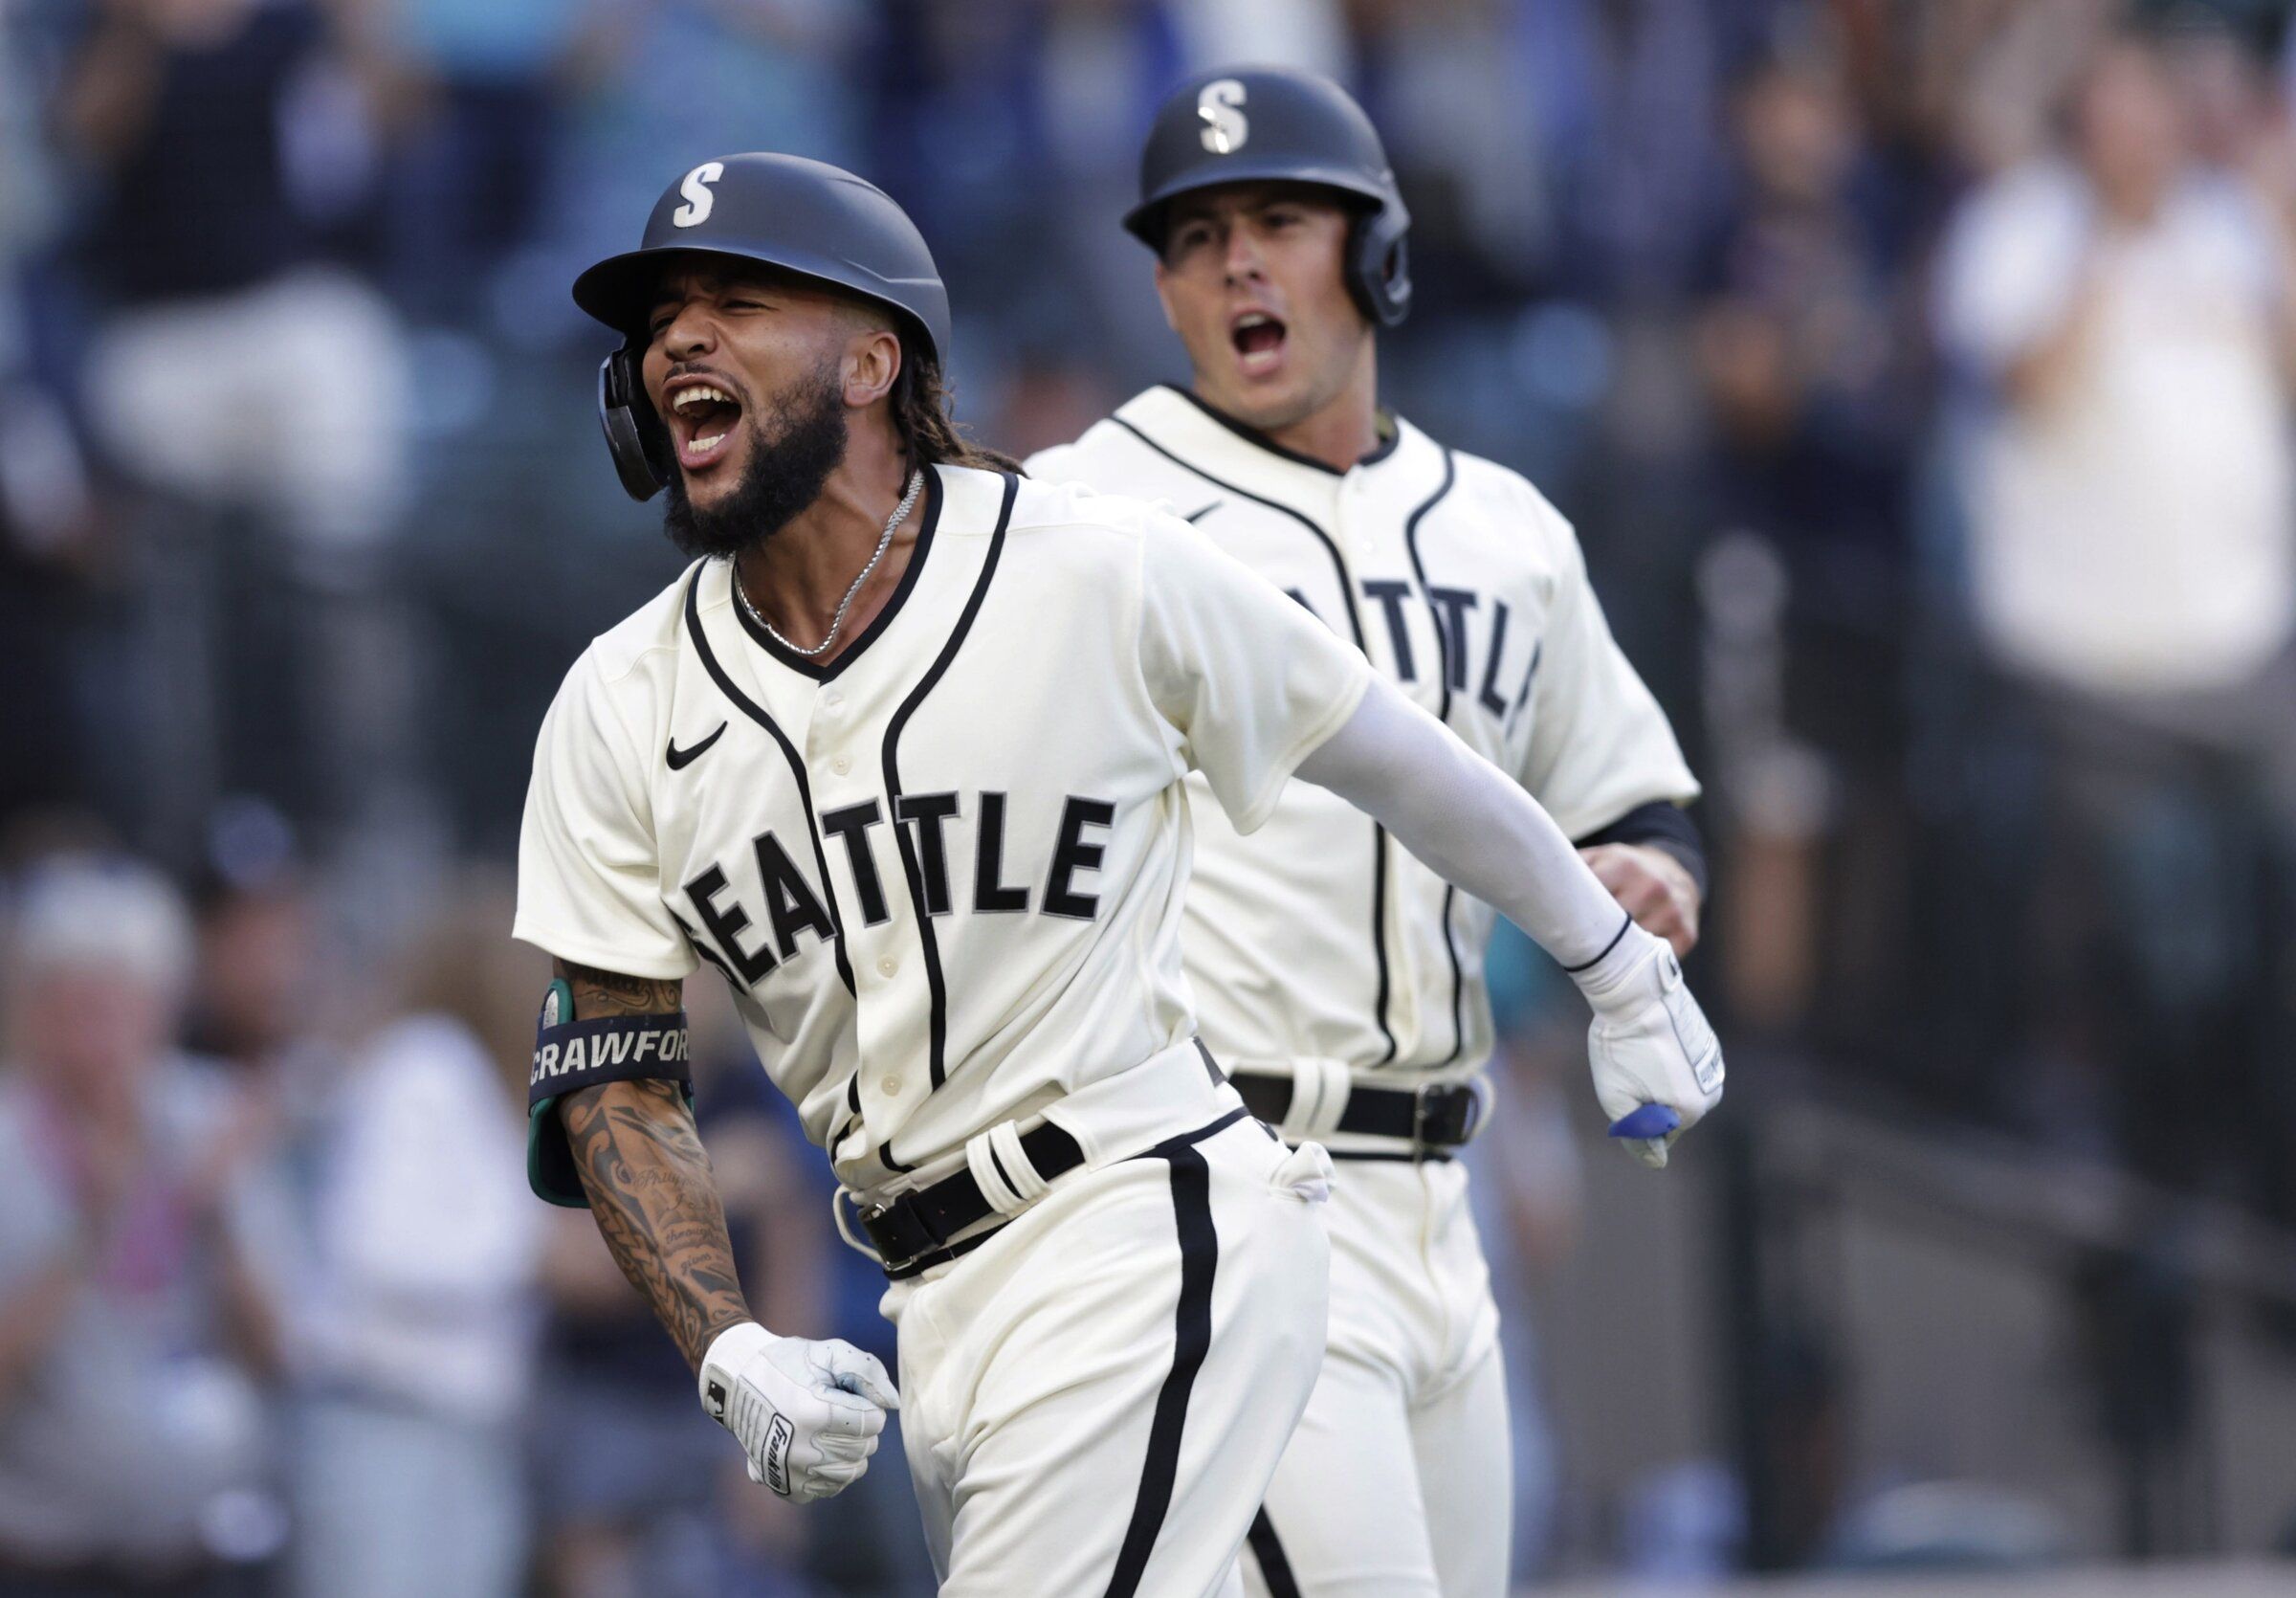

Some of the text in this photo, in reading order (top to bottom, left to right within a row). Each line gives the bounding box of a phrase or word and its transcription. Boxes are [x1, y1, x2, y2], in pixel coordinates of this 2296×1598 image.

[1198, 78, 1249, 154] S
[673, 161, 725, 229] S
[661, 789, 1116, 995] EATTLE
